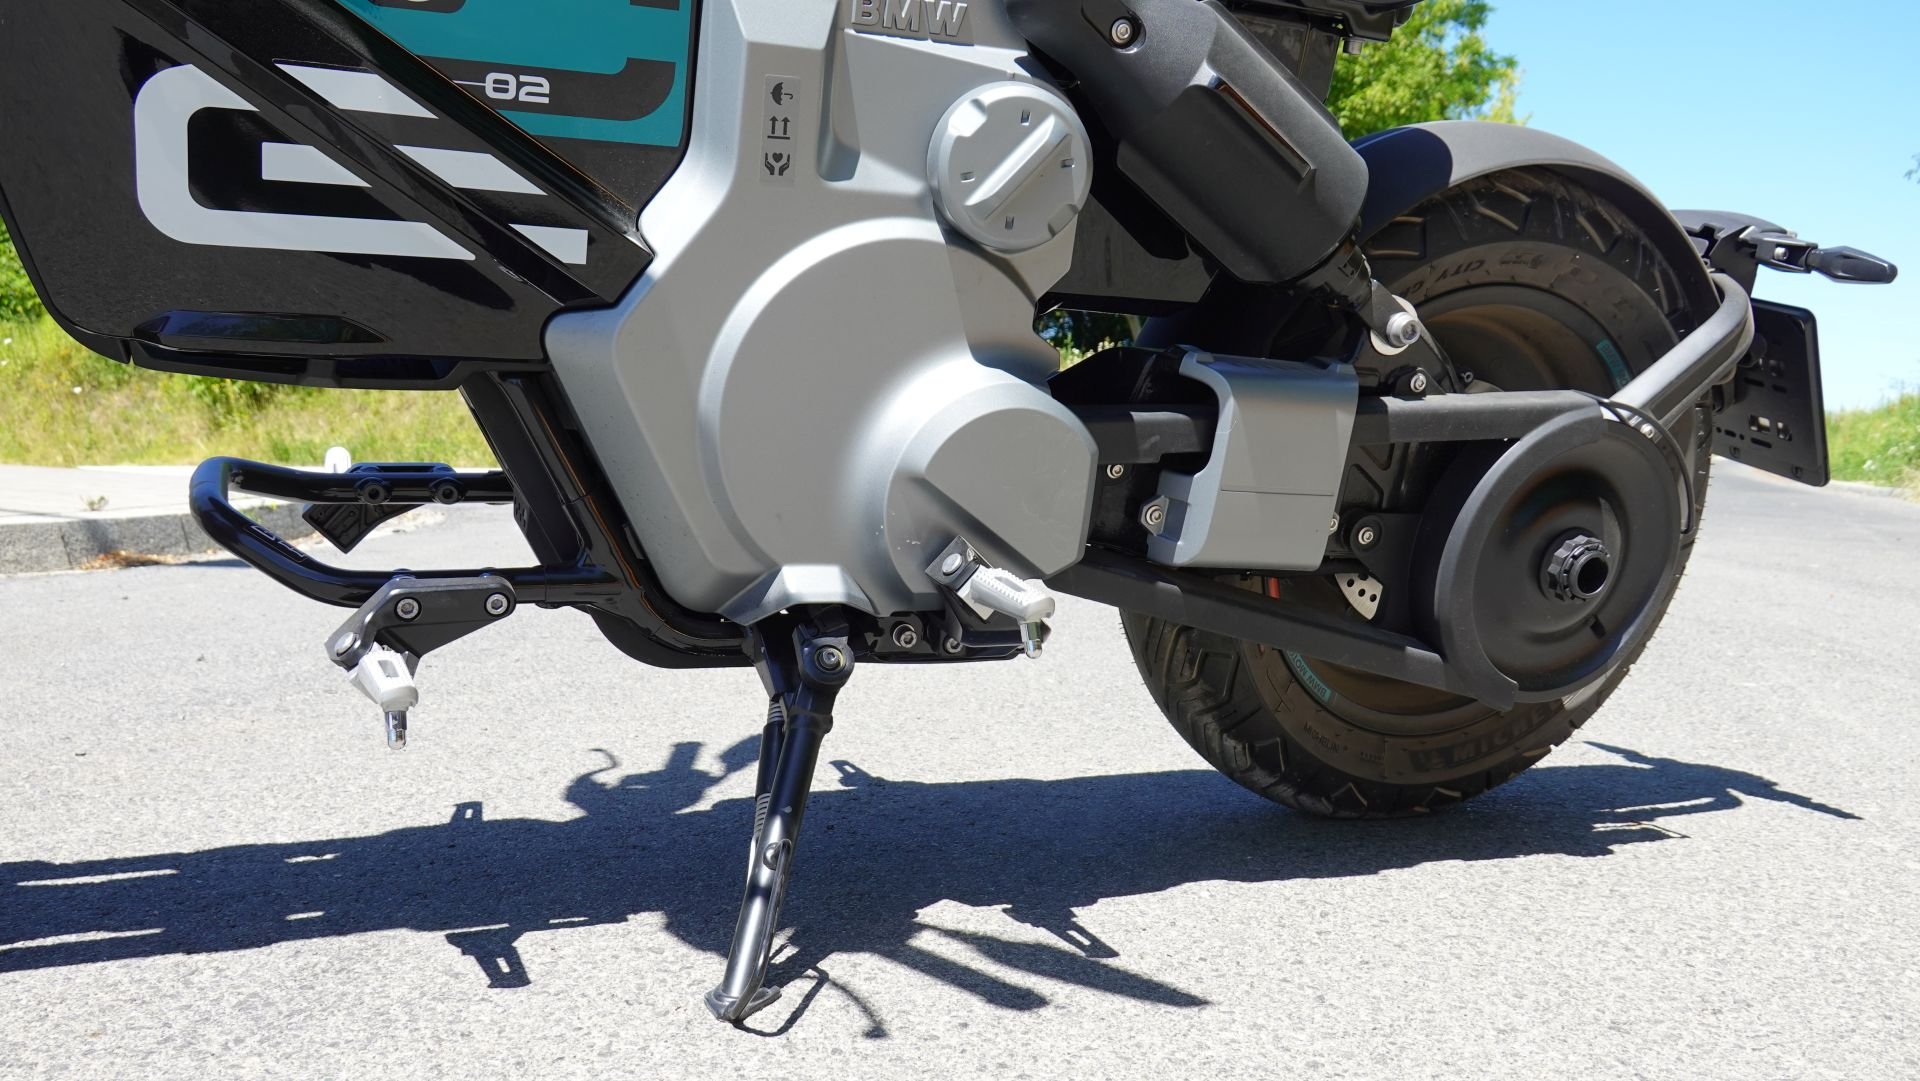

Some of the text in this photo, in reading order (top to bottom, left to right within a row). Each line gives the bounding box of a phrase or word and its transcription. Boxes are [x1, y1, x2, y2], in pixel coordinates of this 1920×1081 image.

[851, 0, 968, 37] BMW
[485, 72, 550, 104] 02
[1434, 259, 1486, 284] CITY
[1306, 675, 1327, 698] BMW
[1303, 720, 1344, 753] MICHELIN
